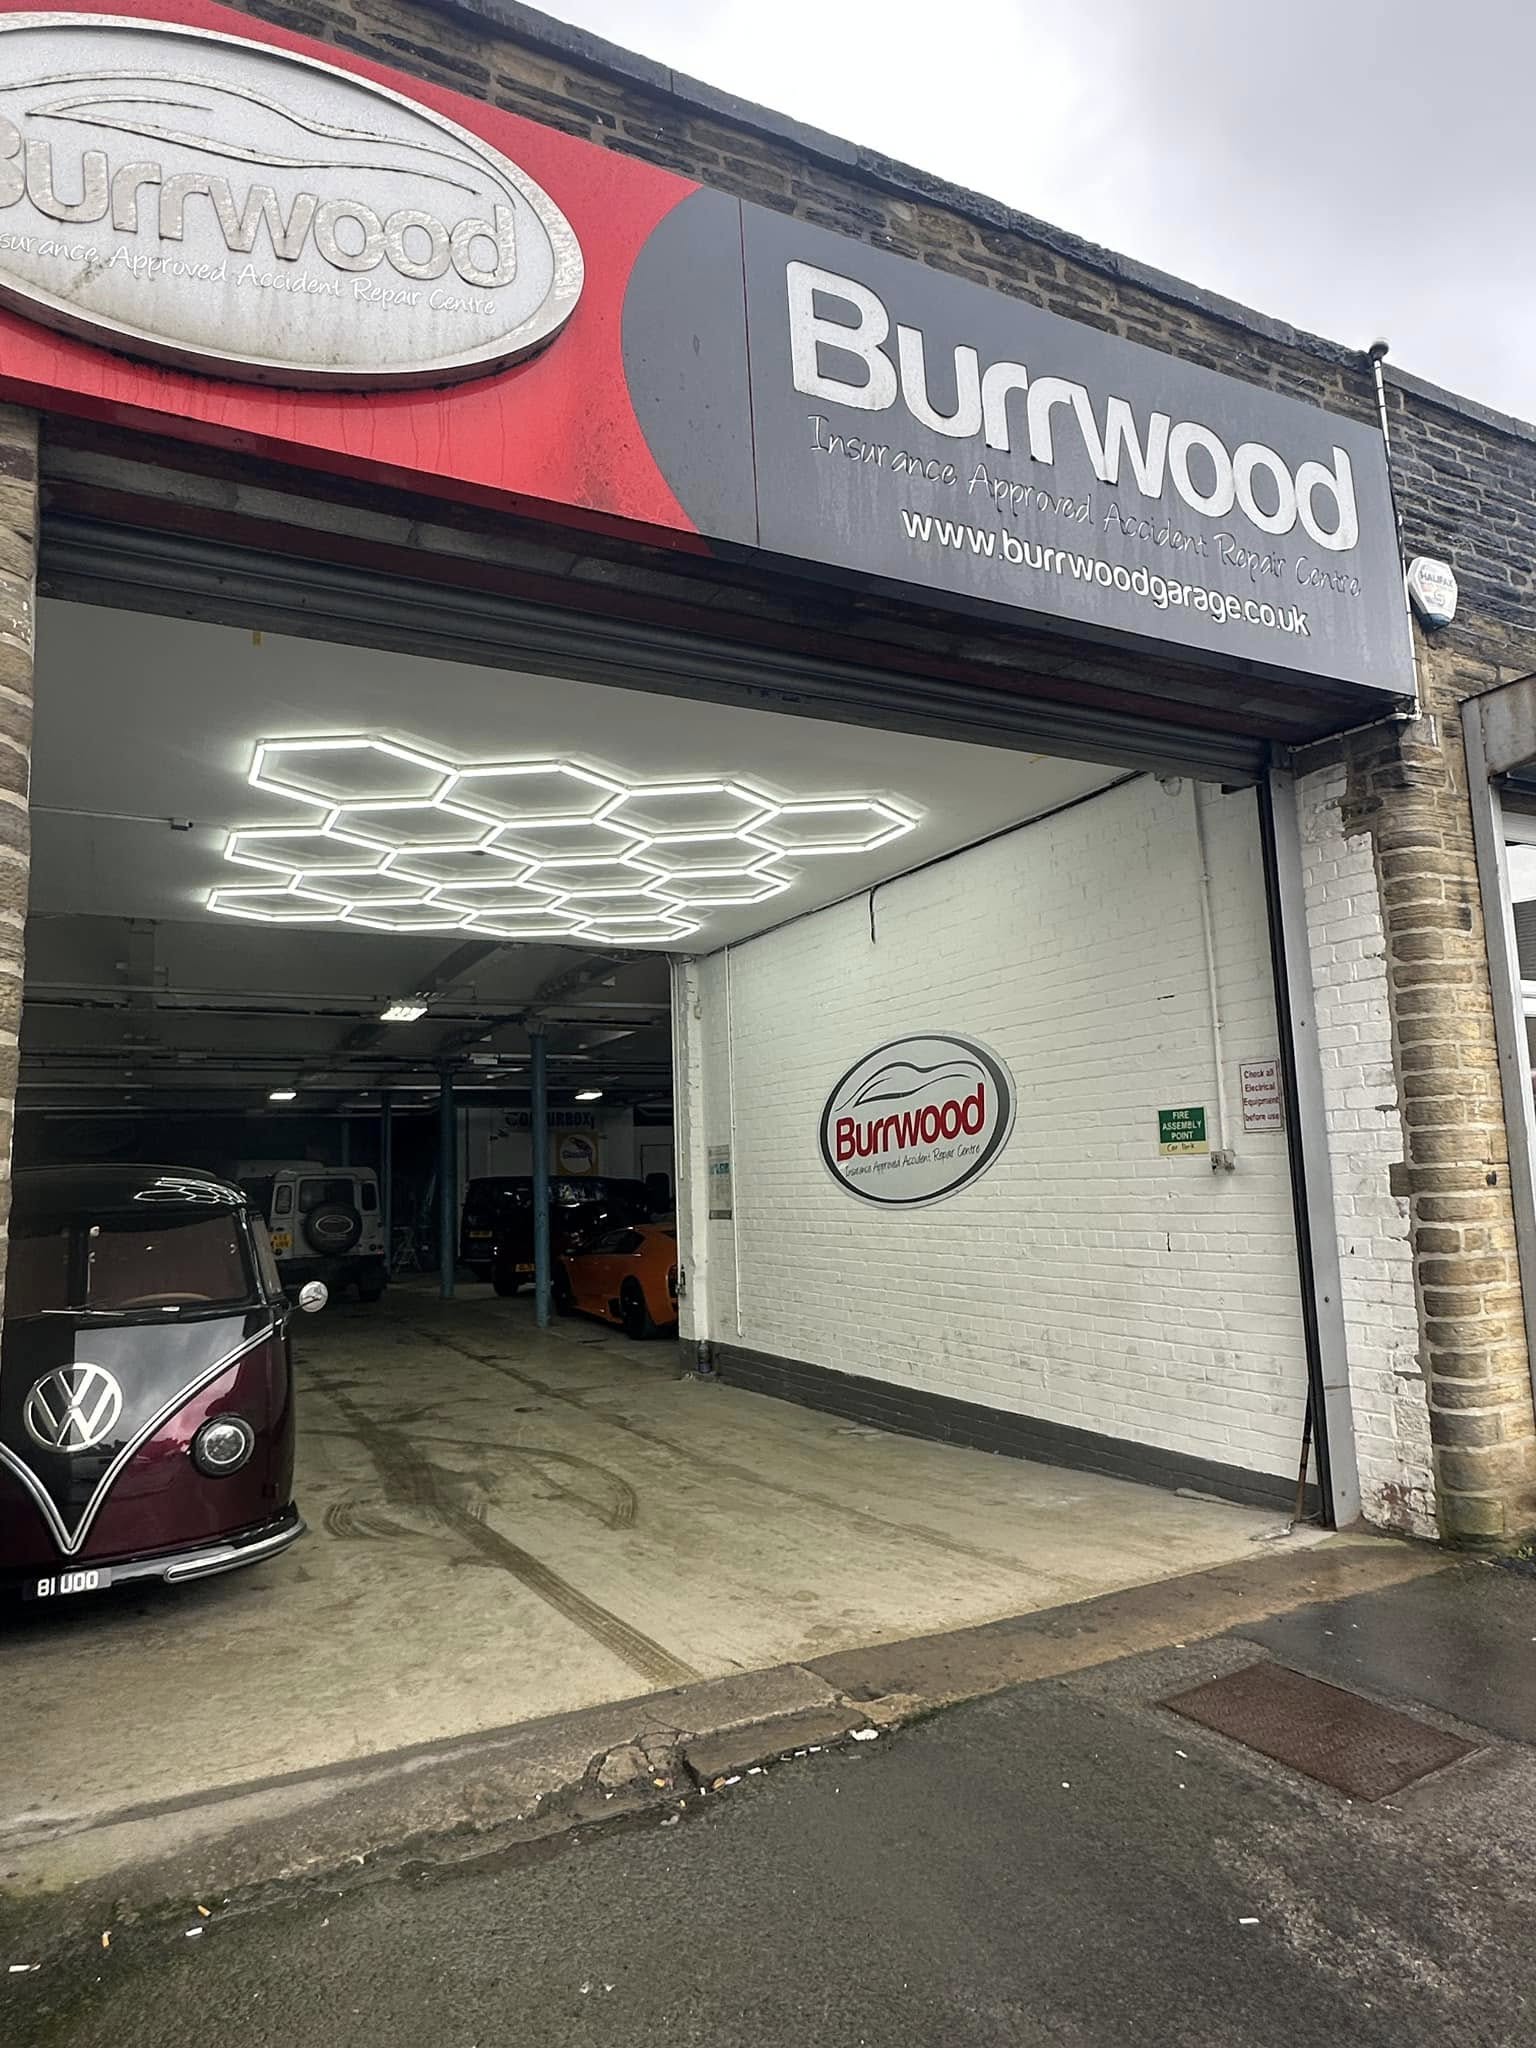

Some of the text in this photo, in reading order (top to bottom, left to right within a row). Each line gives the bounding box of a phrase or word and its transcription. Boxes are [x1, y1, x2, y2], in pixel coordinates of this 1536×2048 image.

[0, 112, 516, 288] urrwood
[0, 232, 496, 315] surance Approved Accident Repair Centre
[787, 259, 1360, 552] Burrwood
[808, 414, 1363, 598] Insurance Approved Accident Repair Centre
[901, 509, 1309, 637] www.burrwoodgarage.co.uk
[1243, 1068, 1274, 1079] Check all
[1244, 1082, 1275, 1092] Electrical
[1243, 1096, 1279, 1107] Equipment
[836, 1082, 985, 1162] Burrwood
[1162, 1120, 1202, 1130] ASSEMBLY
[1172, 1110, 1190, 1120] FIRE
[1245, 1112, 1279, 1122] before use
[1171, 1131, 1193, 1140] POINT
[872, 1159, 901, 1175] Approved
[902, 1151, 931, 1167] Accident
[933, 1146, 954, 1163] Repair
[957, 1143, 981, 1157] Centre
